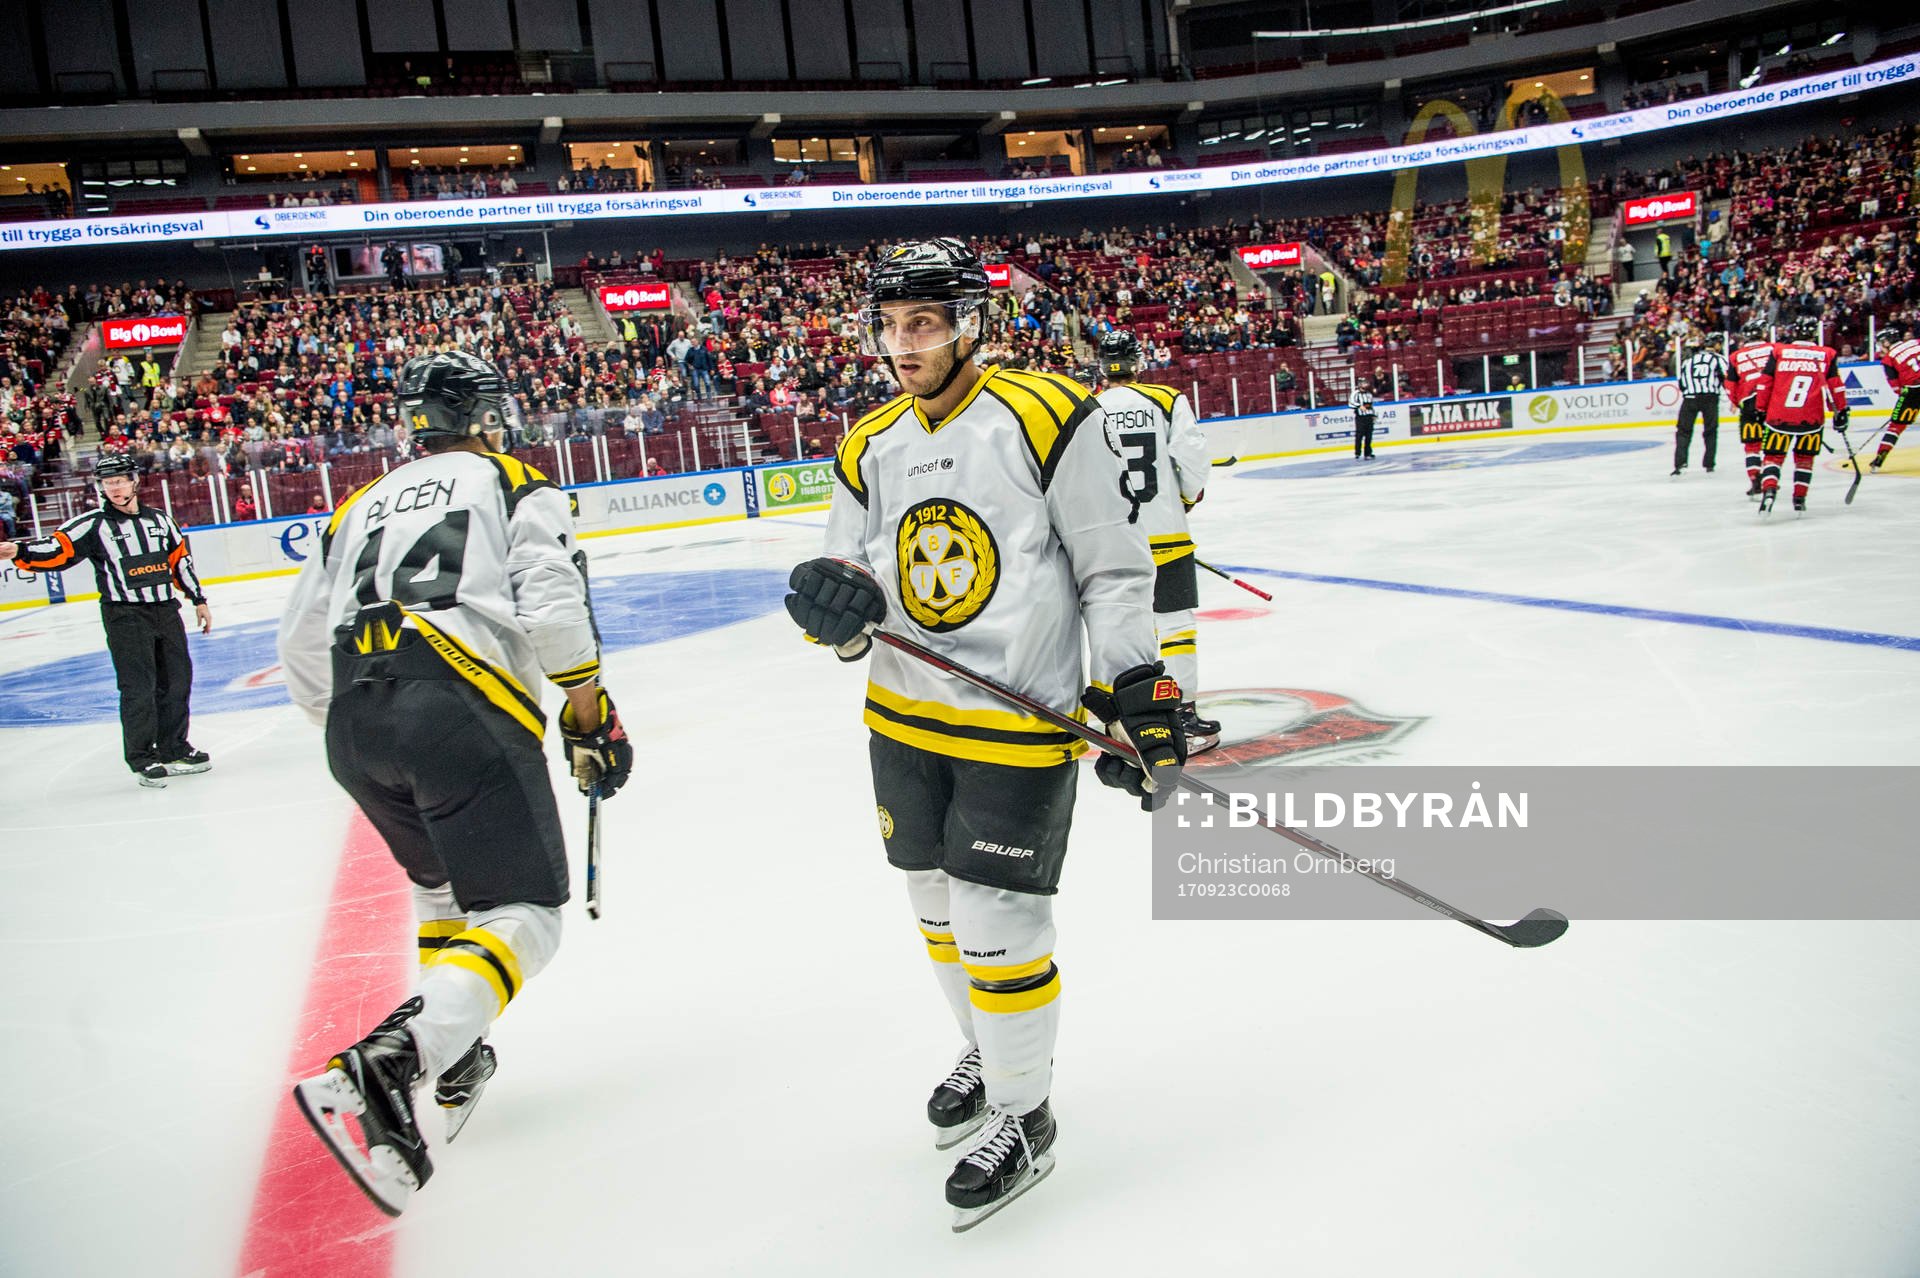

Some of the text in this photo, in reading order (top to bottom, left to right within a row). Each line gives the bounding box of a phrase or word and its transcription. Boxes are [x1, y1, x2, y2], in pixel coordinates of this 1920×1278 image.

[1667, 61, 1915, 121] Din oberoende partner till trygga
[1231, 134, 1529, 181] Din oberoende partner till trygga försäkringsval
[832, 179, 1113, 202] Din oberoende partner till trygga försäkringsval
[364, 196, 703, 222] Din oberoende partner till trygga försäkringsval
[1629, 198, 1691, 218] Big Bowl
[2, 219, 204, 243] till trygga försäkringsval
[1243, 248, 1297, 264] Big Bowl
[606, 290, 666, 306] Big Bowl
[110, 323, 183, 342] Big Bowl
[1693, 364, 1710, 377] 70
[1563, 392, 1629, 410] VOLITO
[1784, 375, 1814, 408] 8
[1420, 400, 1500, 425] TÄTA TAK
[1565, 409, 1629, 421] FASTIGHETER
[1422, 419, 1499, 433] entreprenad
[907, 458, 939, 478] unicef
[608, 488, 702, 515] ALLIANCE
[915, 504, 948, 524] 1912
[927, 534, 940, 551] B
[350, 508, 470, 609] 14
[128, 562, 169, 577] GROLLS
[426, 633, 483, 677] BAUER
[971, 839, 1035, 860] BAUER
[1415, 895, 1454, 917] BAUER
[963, 948, 1007, 959] BAUER
